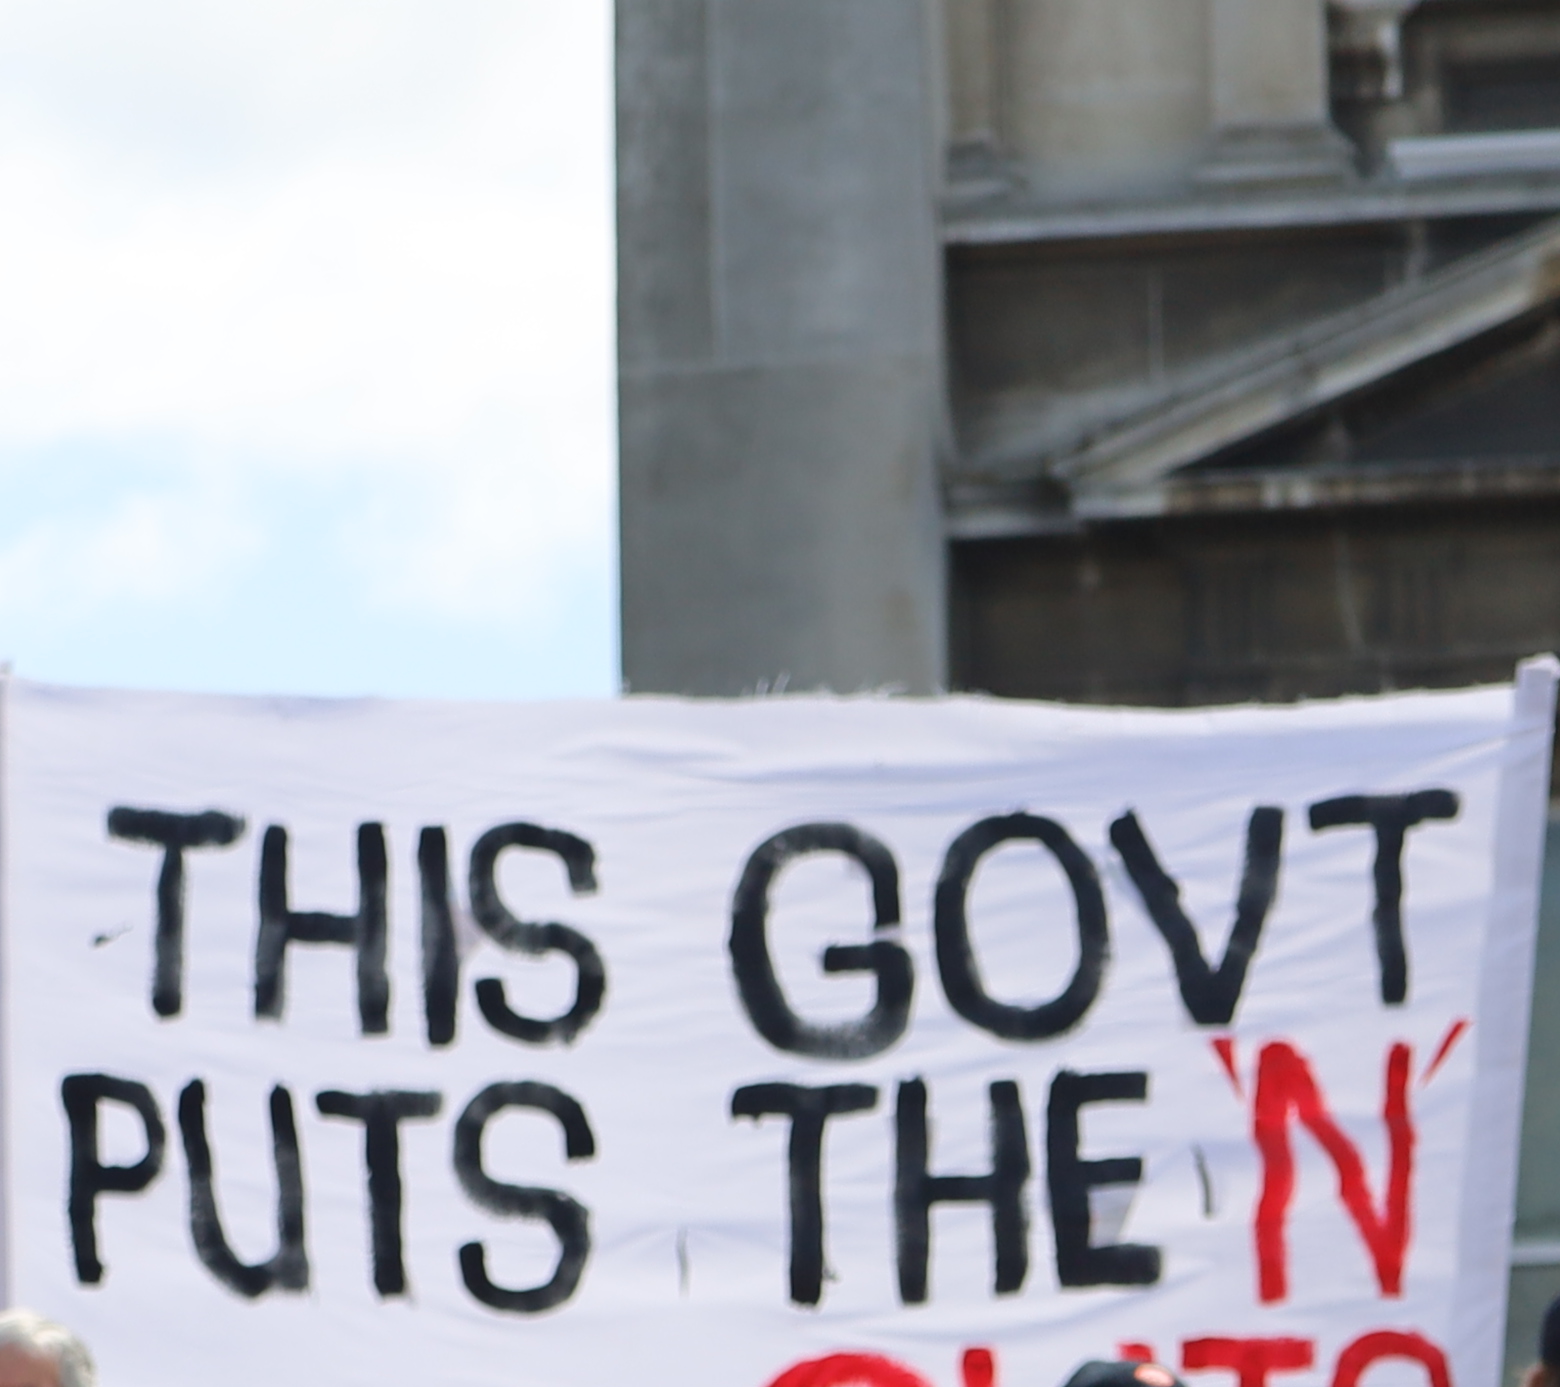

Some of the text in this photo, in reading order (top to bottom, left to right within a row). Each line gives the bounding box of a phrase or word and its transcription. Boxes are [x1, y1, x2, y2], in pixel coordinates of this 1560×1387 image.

[107, 788, 1459, 1059] THIS GOVT
[60, 1071, 596, 1313] PUTS
[731, 1069, 1164, 1306] THE
